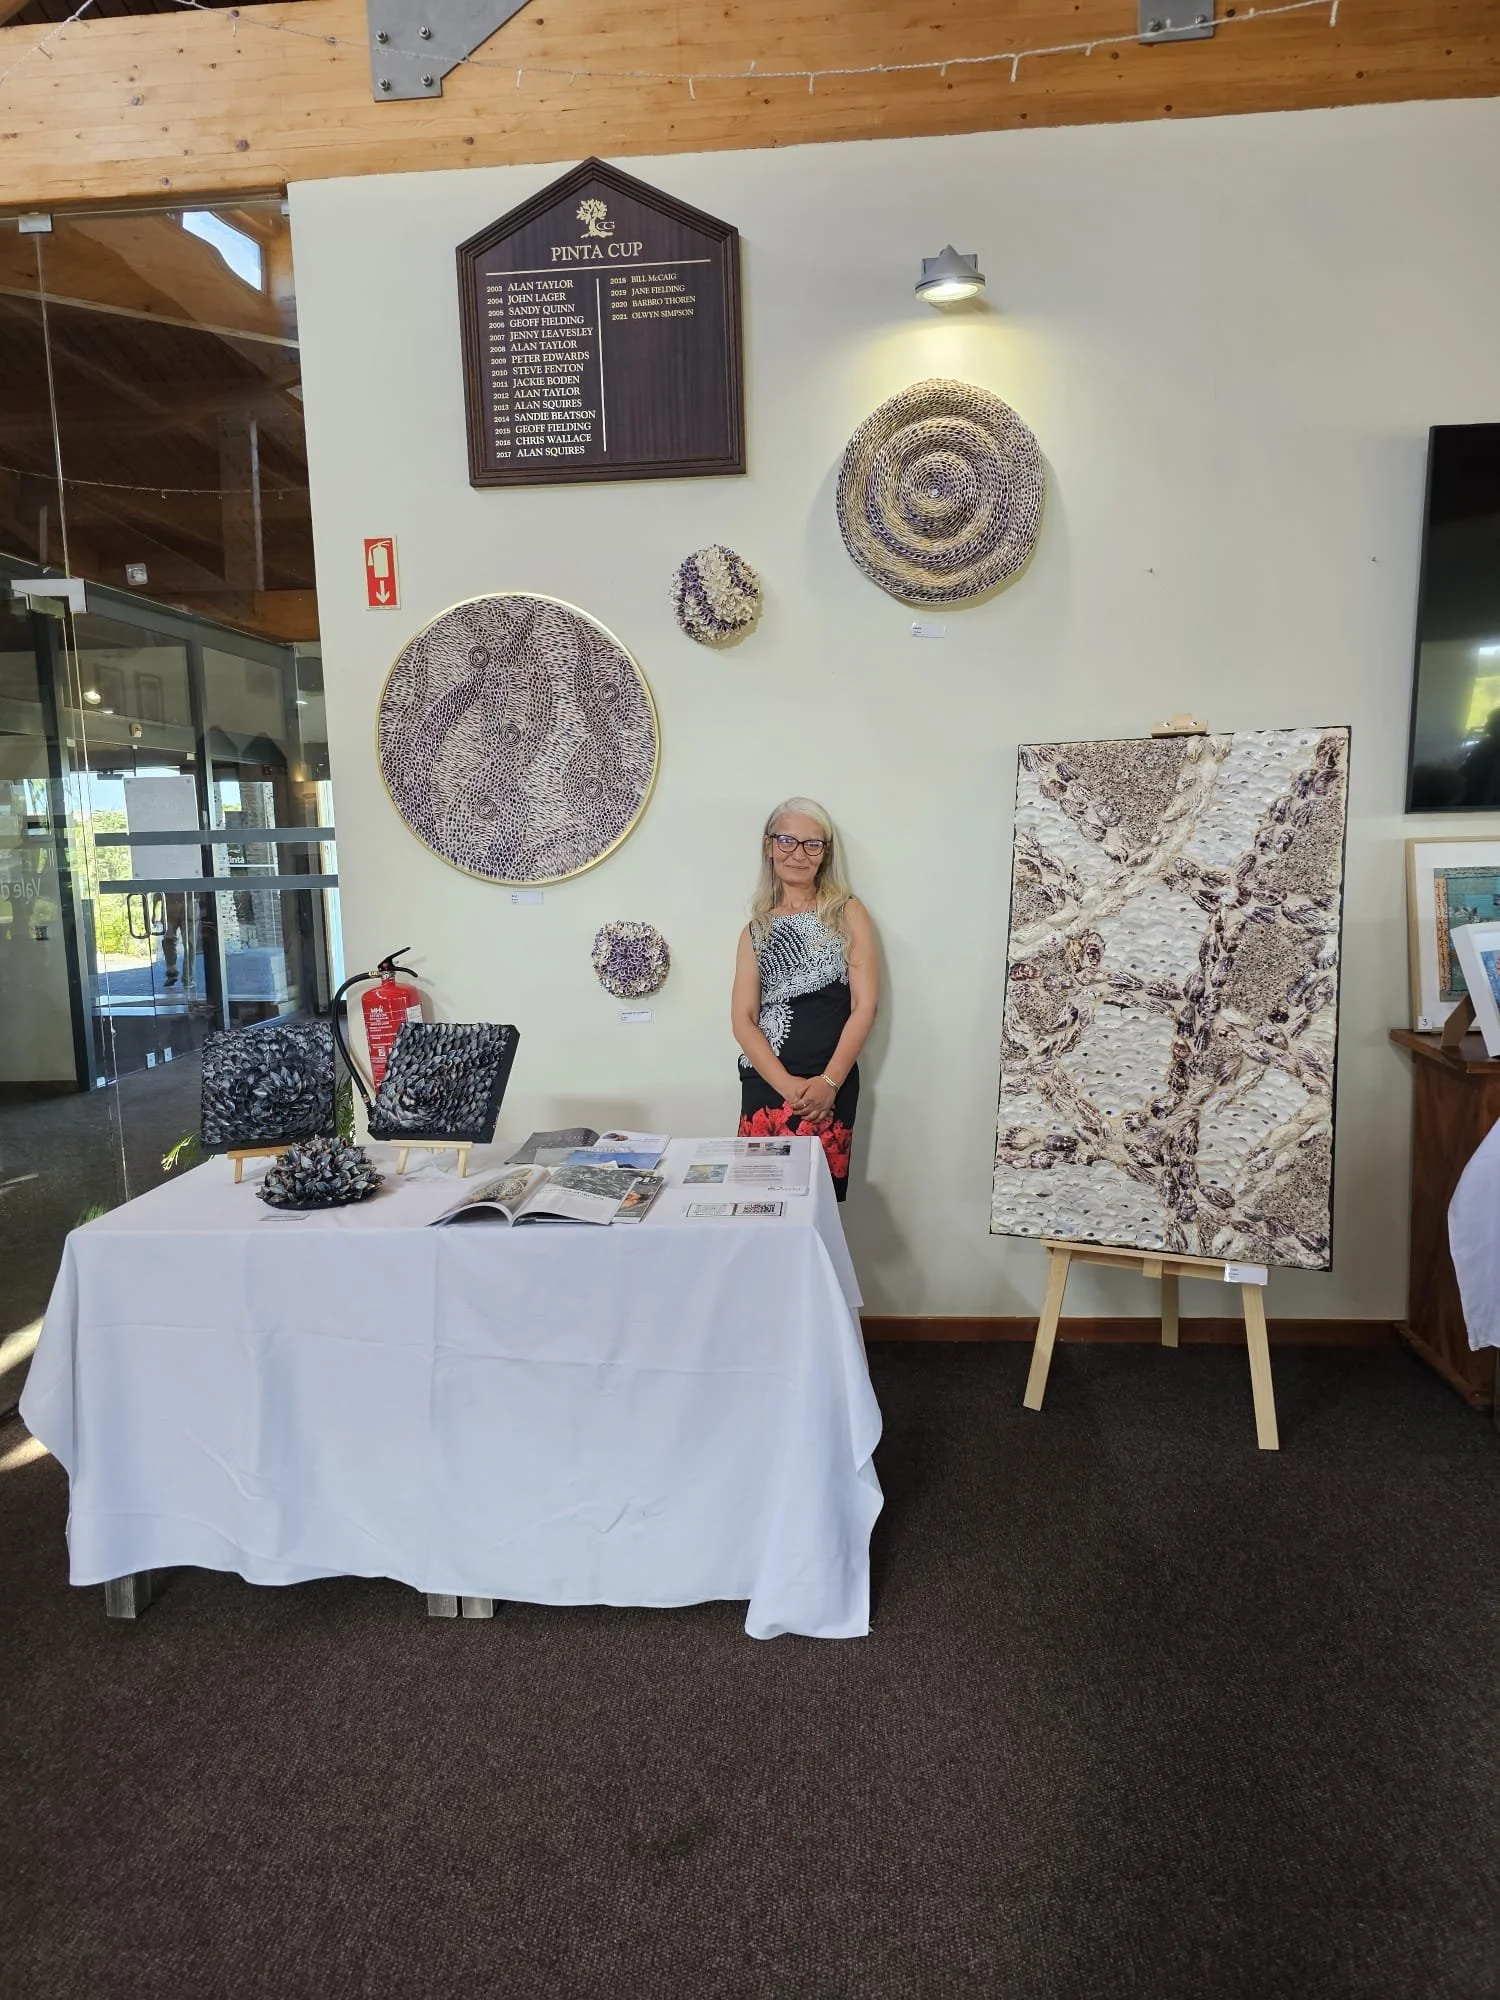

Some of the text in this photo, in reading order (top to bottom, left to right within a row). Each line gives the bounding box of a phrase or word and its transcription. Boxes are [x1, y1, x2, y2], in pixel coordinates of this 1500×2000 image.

[551, 242, 642, 261] PINTA CUP
[648, 273, 676, 282] McCAIG
[508, 282, 533, 291] ALAN
[536, 280, 574, 289] TAYLOR
[632, 288, 650, 296] JANE
[652, 285, 685, 294] FIELDING
[508, 295, 533, 305] JOHN
[536, 293, 566, 301] LAGER
[633, 298, 662, 307] BARBRO
[664, 296, 696, 304] THOREN
[509, 306, 540, 315] SANDY
[543, 304, 575, 314] QUINN
[632, 311, 659, 319] OLWYN
[661, 309, 694, 317] SIMPSON
[510, 318, 539, 328] GEOFF
[541, 316, 584, 326] FIELDING
[510, 330, 539, 341] JENNY
[542, 328, 593, 338] LEAVESLEY
[510, 342, 537, 352] ALAN
[539, 340, 577, 350] TAYLOR
[512, 354, 540, 364] PETER
[543, 352, 589, 361] EDWARDS
[513, 366, 542, 375] STEVE
[545, 363, 584, 373] FENTON
[513, 378, 545, 388] JACKIE
[547, 376, 580, 385] BODEN
[514, 389, 540, 398] ALAN
[542, 387, 580, 397] TAYLOR
[514, 401, 540, 410] ALAN
[543, 399, 582, 410] SQUIRES
[515, 413, 549, 422] SANDIE
[551, 410, 596, 420] BEATSON
[515, 424, 546, 434] GEOFF
[547, 422, 592, 432] FIELDING
[516, 436, 544, 445] CHRIS
[547, 434, 592, 443] WALLACE
[516, 448, 543, 457] ALAN
[545, 446, 585, 456] SQUIRES
[1422, 1018, 1428, 1026] 3
